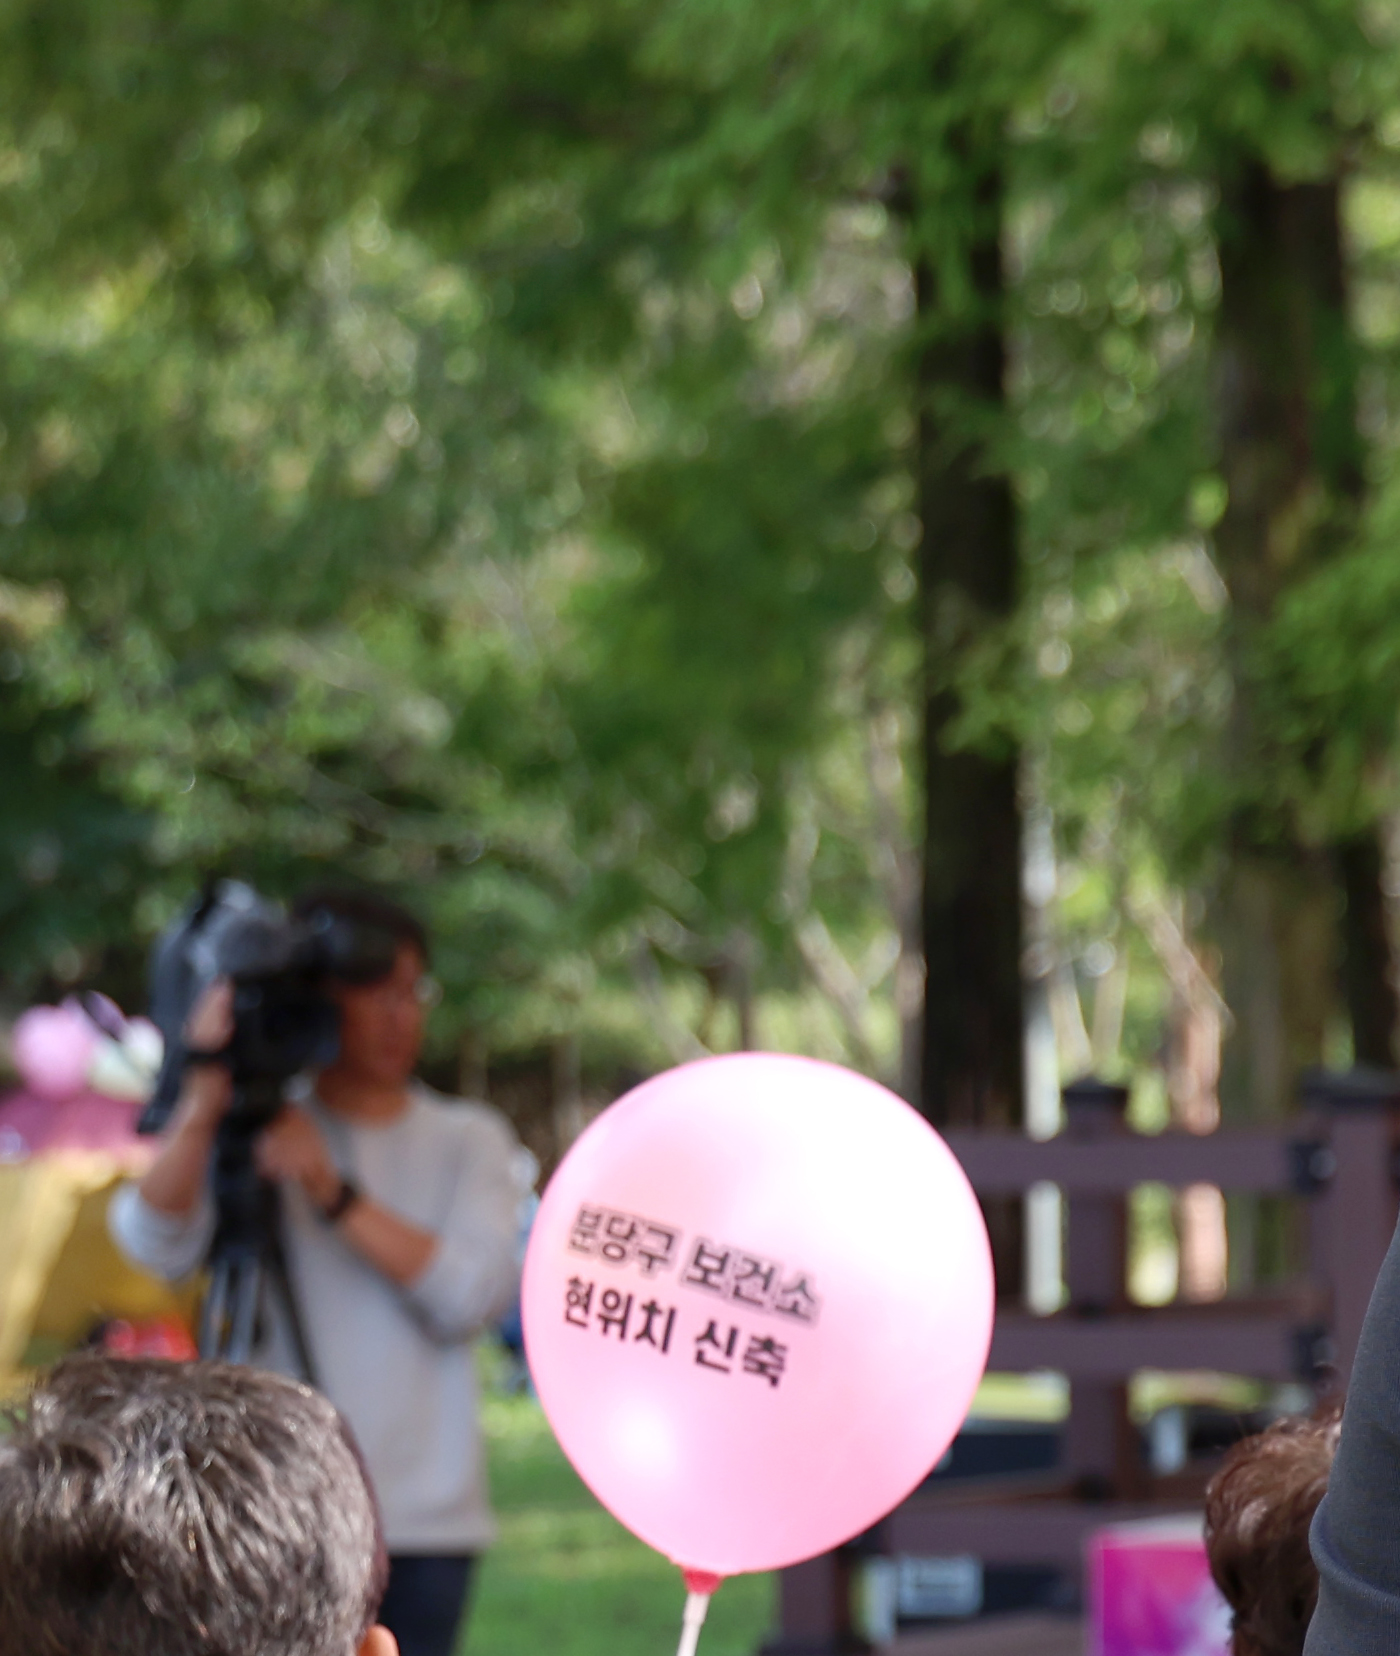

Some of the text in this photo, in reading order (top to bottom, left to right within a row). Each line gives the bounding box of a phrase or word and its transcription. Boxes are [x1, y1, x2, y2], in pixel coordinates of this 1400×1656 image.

[567, 1202, 822, 1328] 분당구 보건소
[564, 1275, 788, 1389] 현위치 신축
